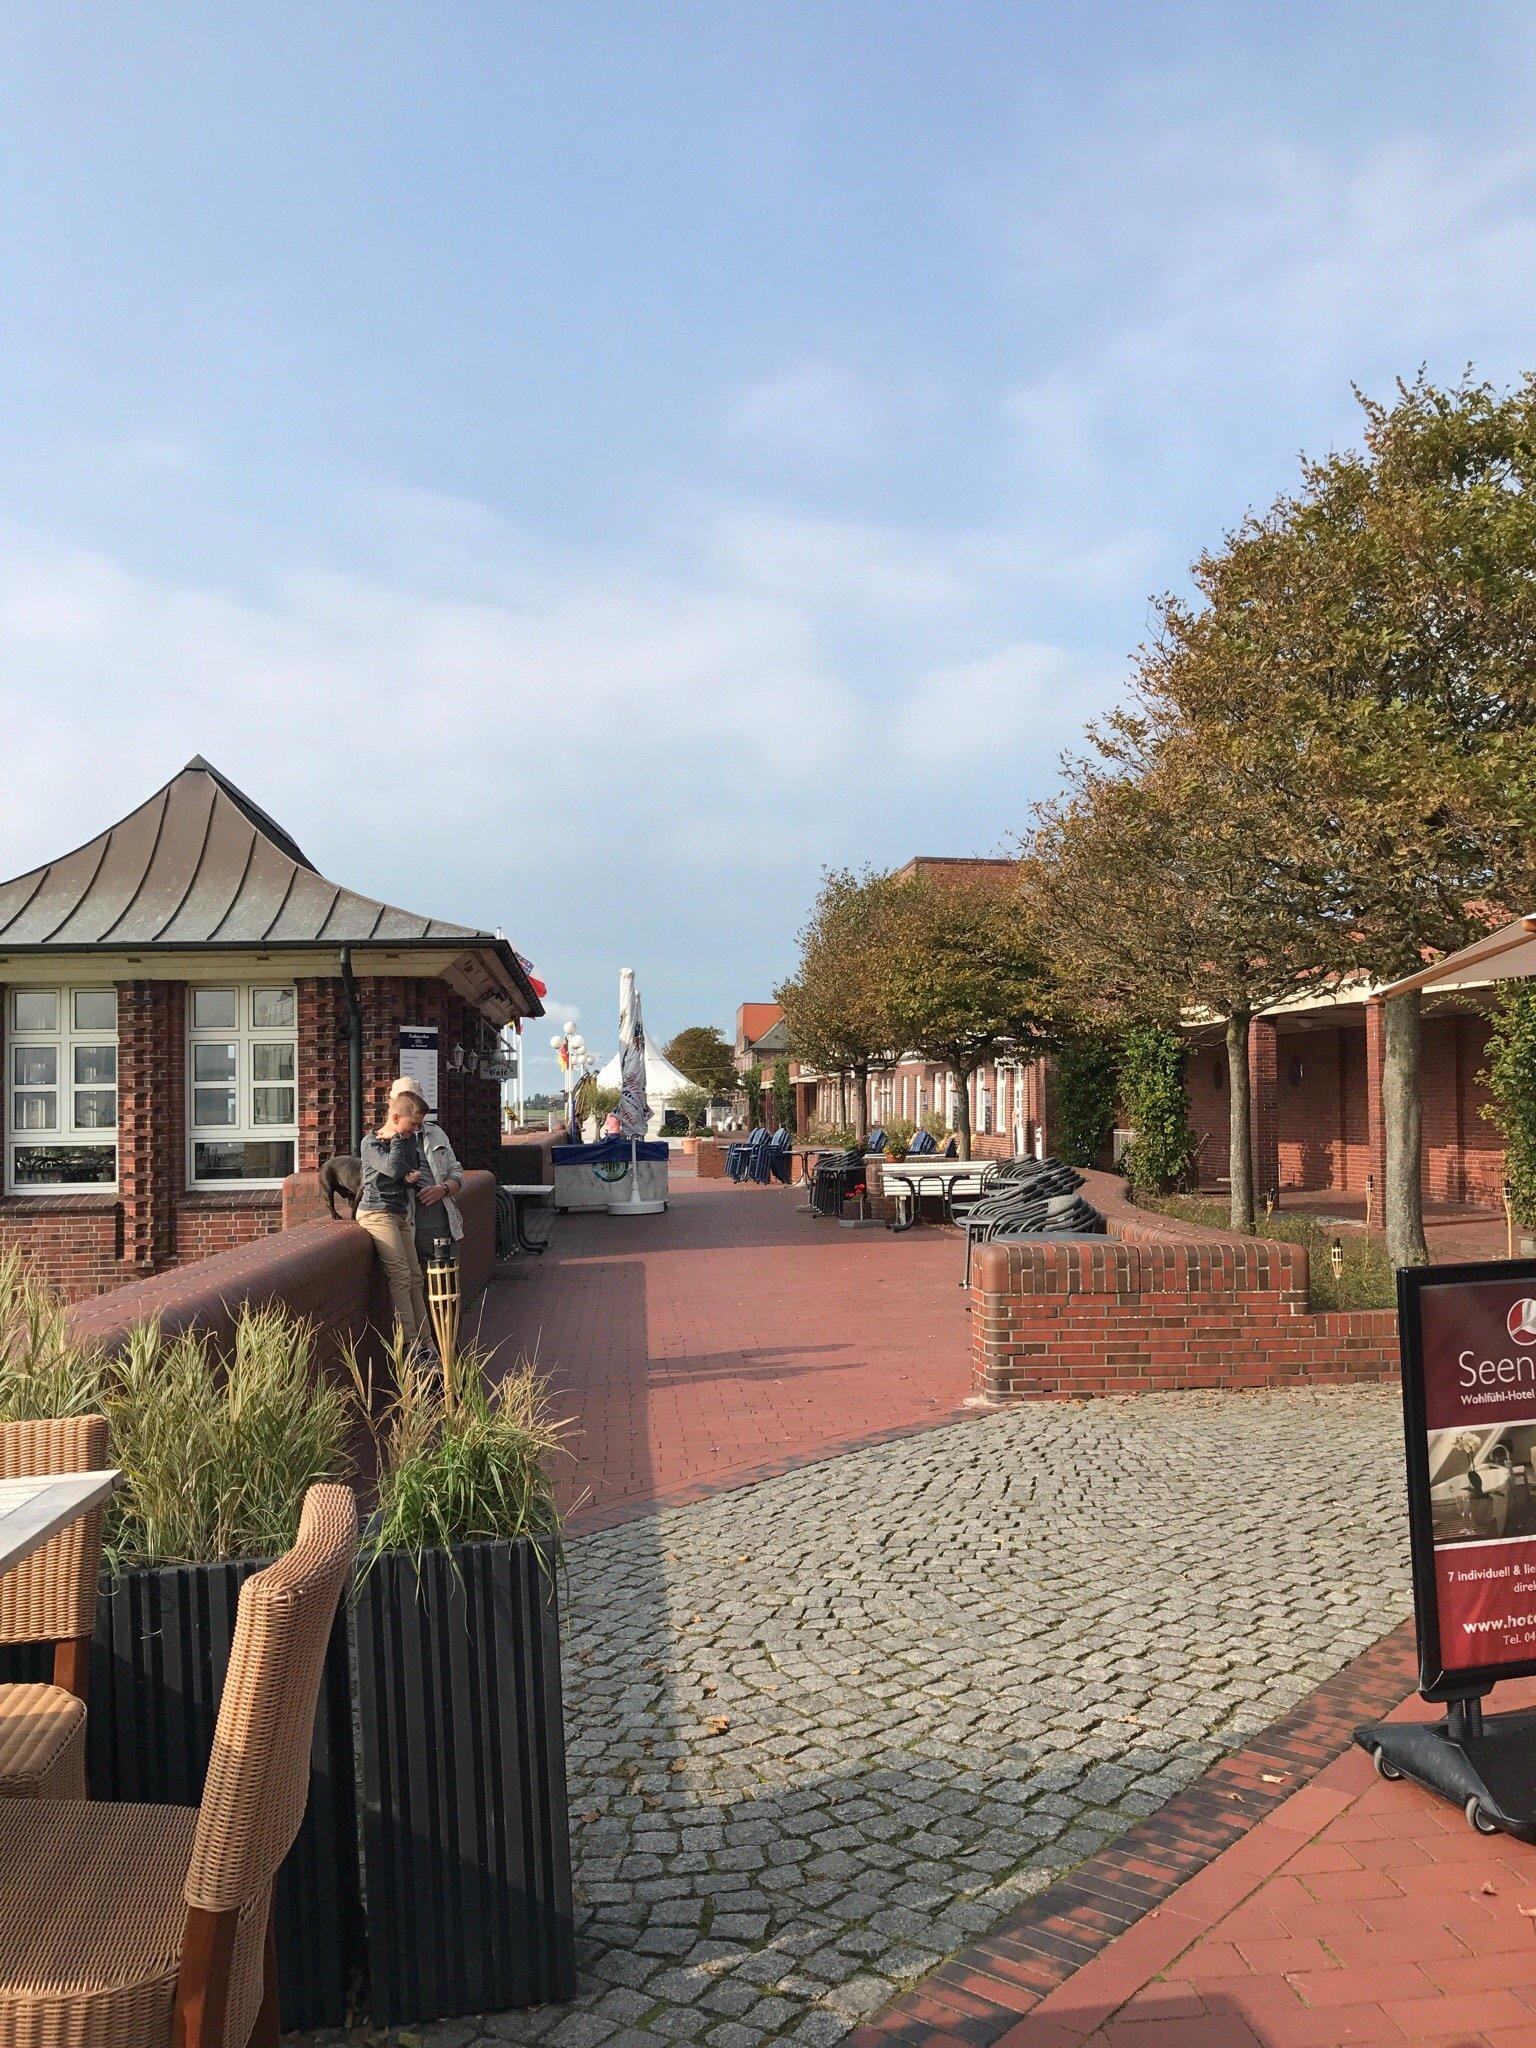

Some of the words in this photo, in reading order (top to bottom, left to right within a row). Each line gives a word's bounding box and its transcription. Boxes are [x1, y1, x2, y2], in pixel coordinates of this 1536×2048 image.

[1458, 1350, 1536, 1387] Seen
[1461, 1388, 1536, 1405] Wohlfühl-Hotel
[1448, 1572, 1454, 1582] 7
[1458, 1566, 1511, 1582] individuell
[1513, 1565, 1521, 1576] &
[1503, 1634, 1522, 1645] Tel.
[1524, 1631, 1536, 1643] 04
